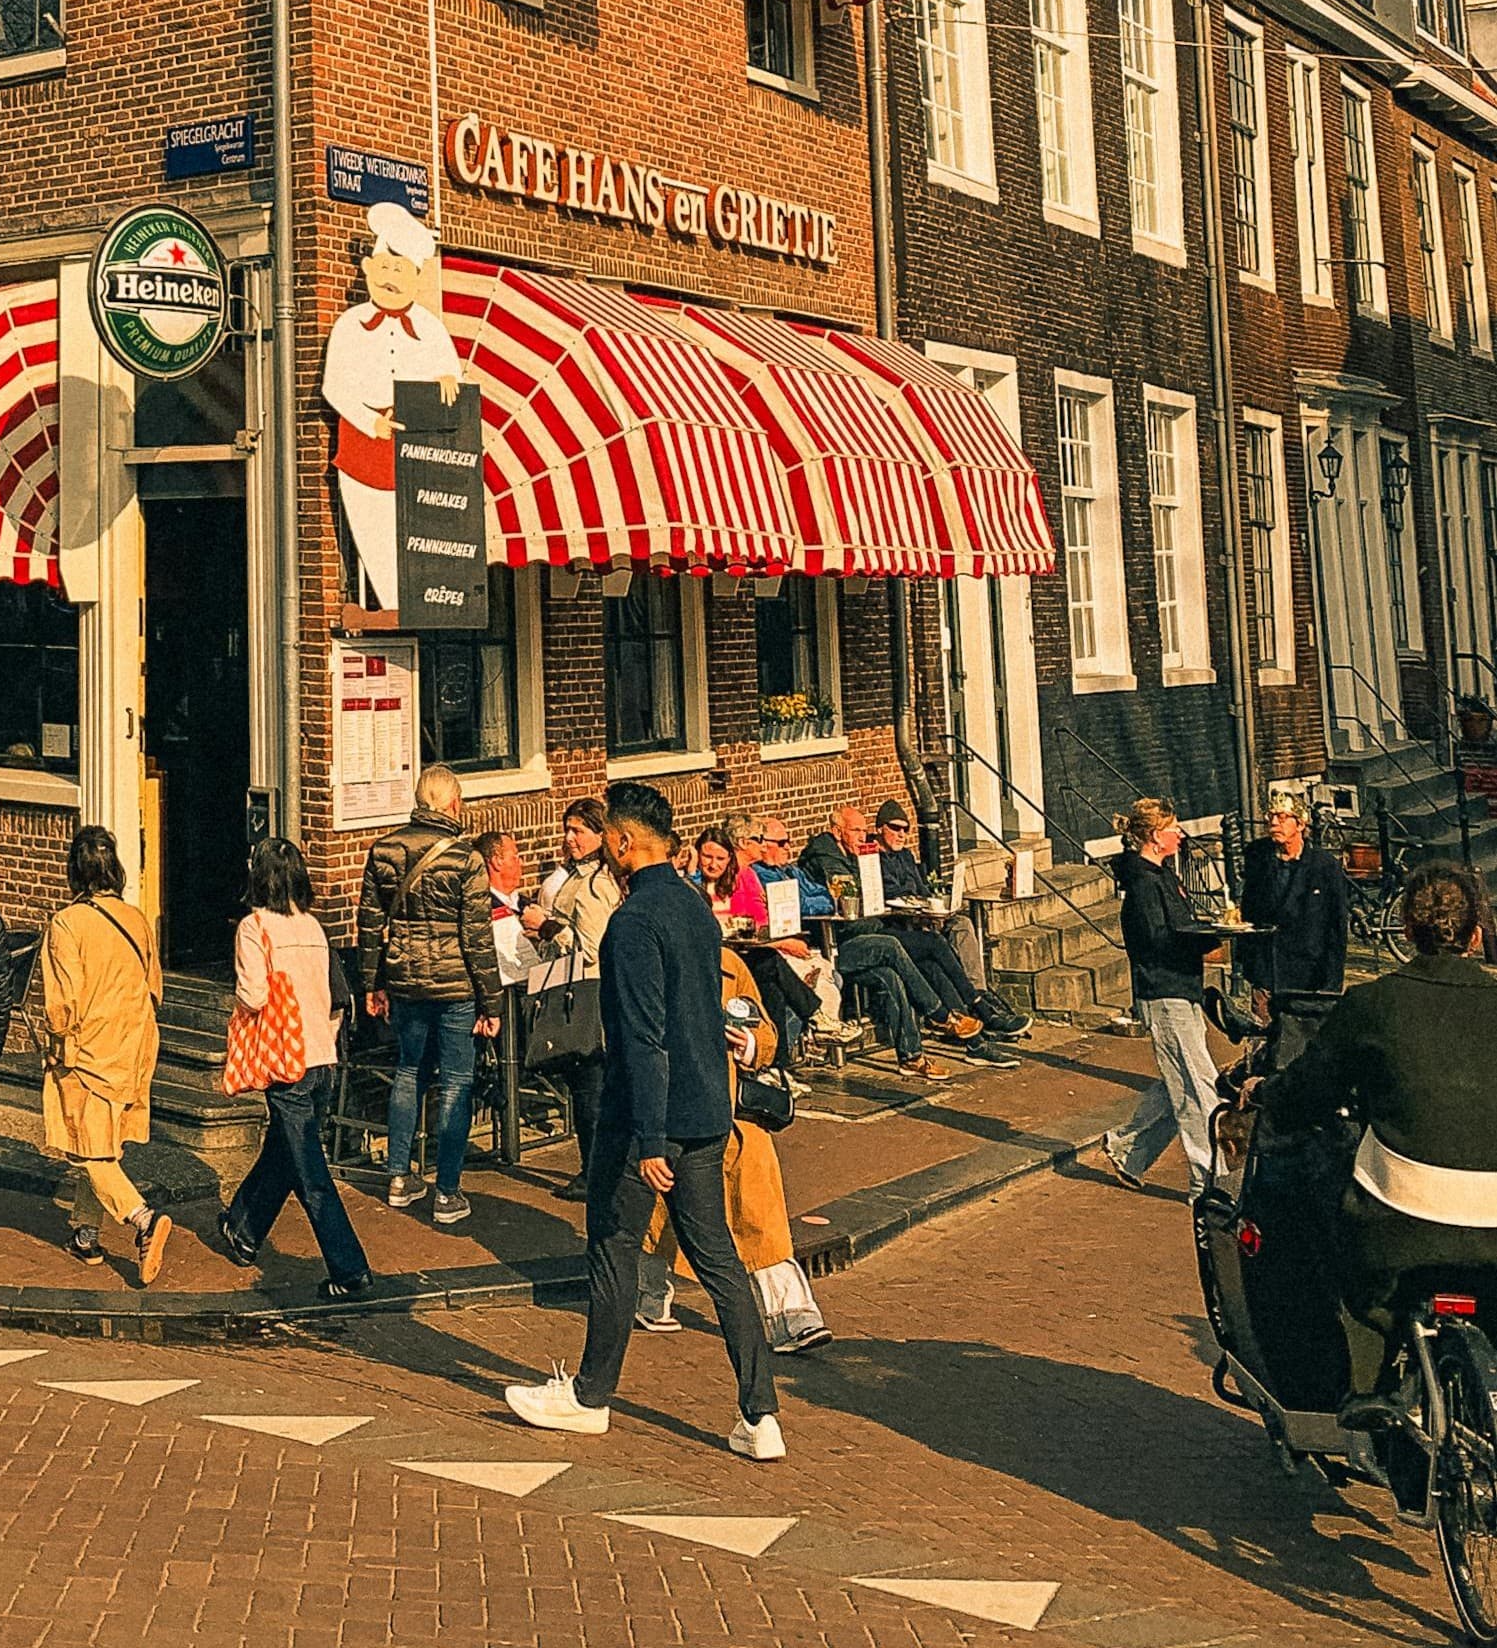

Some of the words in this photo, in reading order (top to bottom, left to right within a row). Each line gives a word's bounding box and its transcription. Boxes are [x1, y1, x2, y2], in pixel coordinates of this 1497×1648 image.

[170, 119, 245, 148] SPIEGELGRACHT
[332, 149, 365, 173] TWEEDE
[333, 170, 362, 193] STRAAT
[451, 114, 560, 203] CAFE
[565, 150, 665, 229] HANS
[673, 188, 708, 236] en
[713, 184, 839, 265] GRIETJE
[122, 221, 171, 255] HEINEKEN
[172, 221, 211, 260] PILSENER
[116, 273, 220, 307] Heineken
[122, 319, 171, 363] PREMIUM
[173, 326, 213, 363] QUALITY
[400, 442, 479, 469] PANNENKOEKEN
[416, 488, 469, 511] PANCAKES
[406, 536, 478, 560] PFANNKUCHEN
[423, 585, 465, 606] CRÊPES
